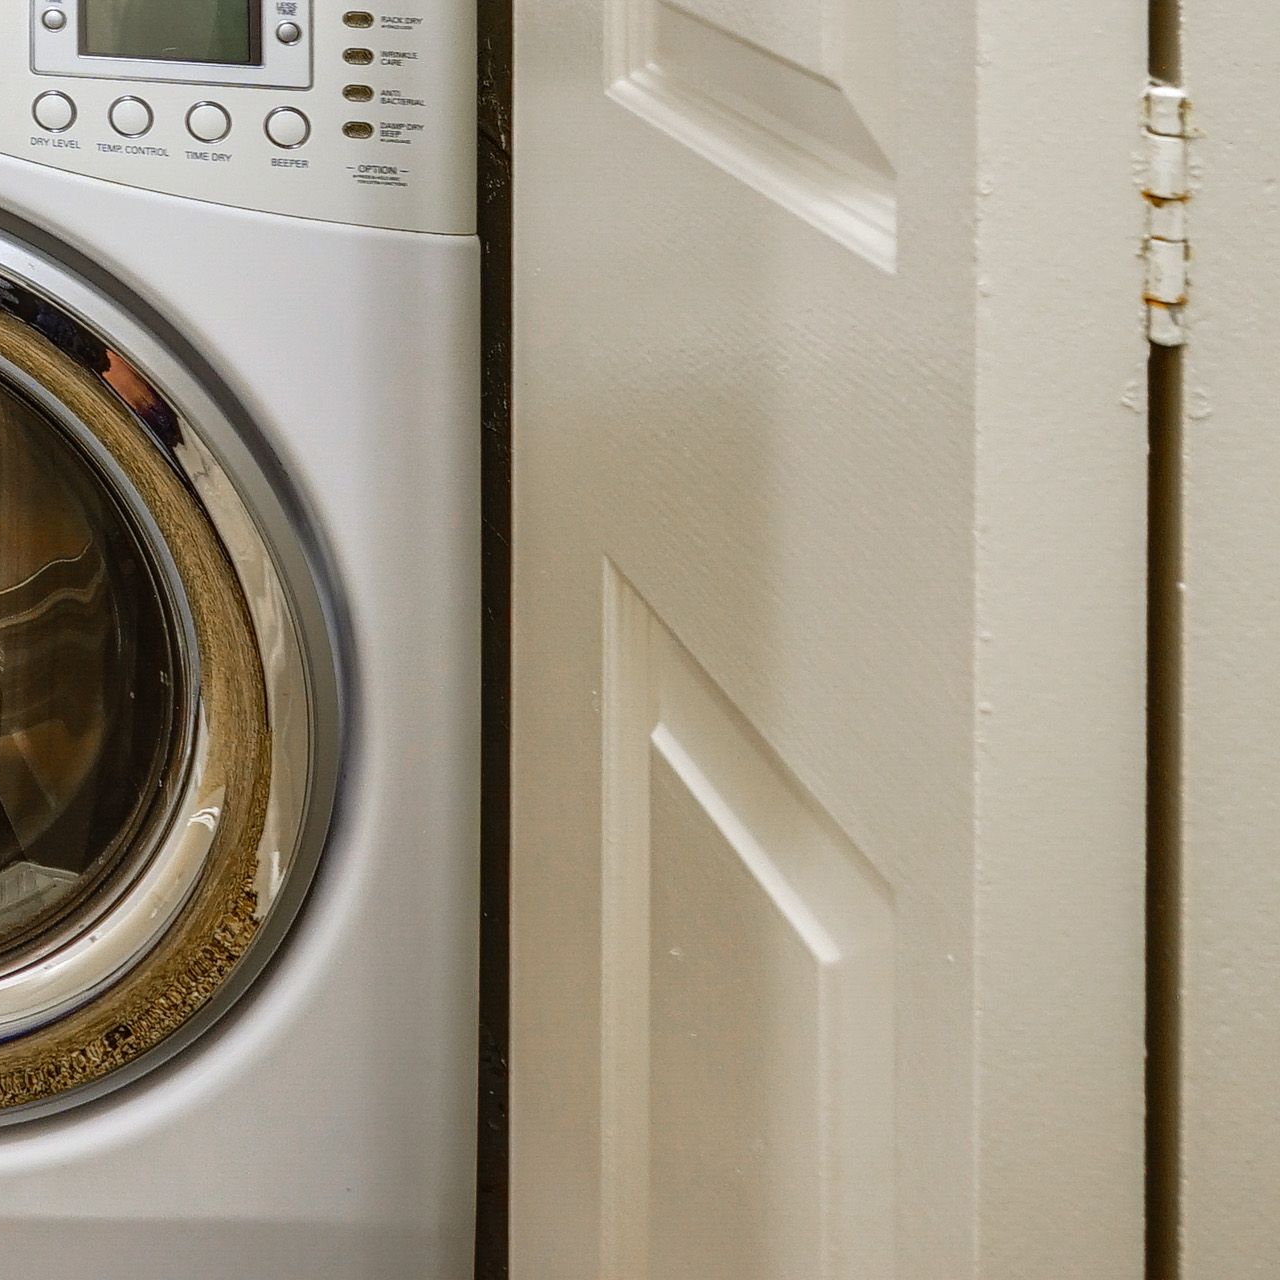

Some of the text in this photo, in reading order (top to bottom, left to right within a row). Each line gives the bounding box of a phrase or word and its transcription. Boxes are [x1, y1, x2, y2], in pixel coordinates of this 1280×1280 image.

[30, 136, 81, 150] DRY LEVEL
[124, 144, 170, 157] CONTROL
[185, 150, 233, 163] TIME DRY
[270, 158, 309, 169] BEEPER
[357, 164, 398, 175] OPTION
